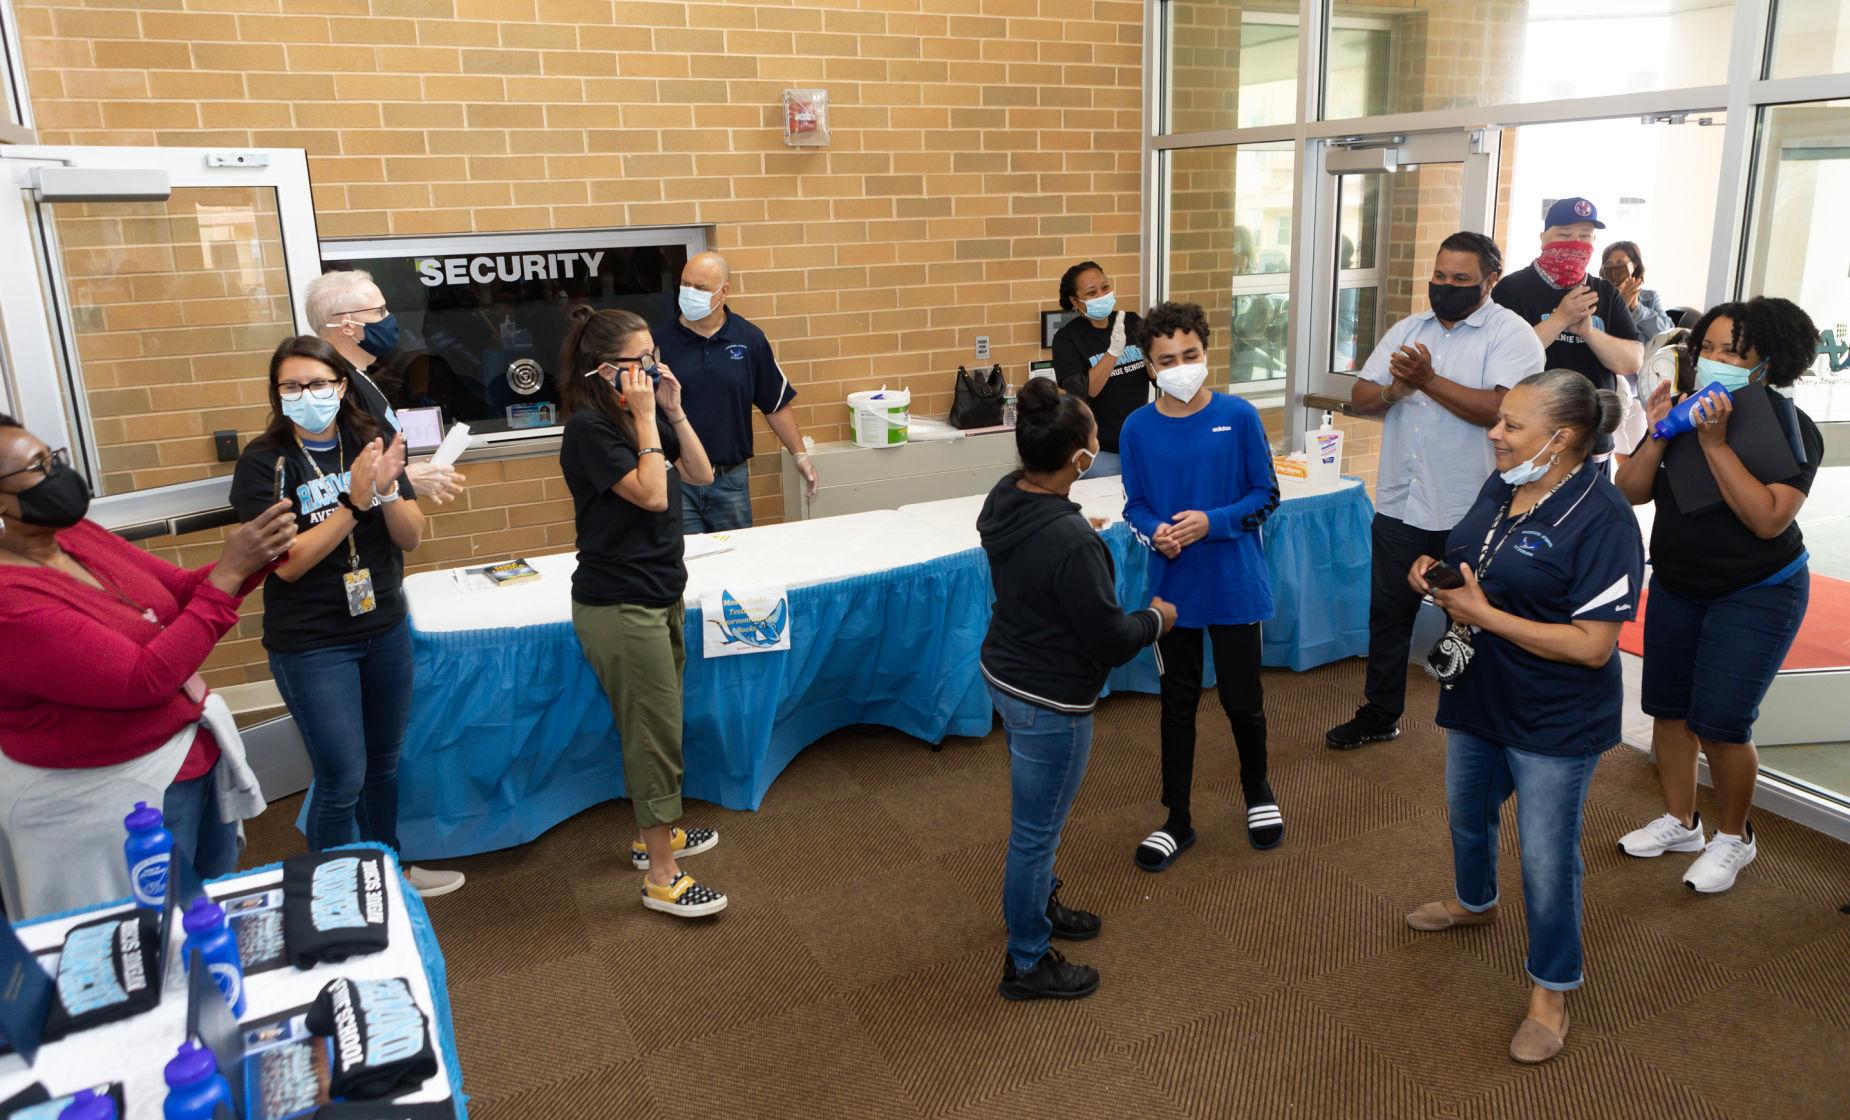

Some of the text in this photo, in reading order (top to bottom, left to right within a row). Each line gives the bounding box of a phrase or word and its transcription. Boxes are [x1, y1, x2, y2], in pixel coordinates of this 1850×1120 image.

[419, 251, 605, 287] SECURITY
[1110, 360, 1146, 377] NUE SCHOO
[335, 1007, 364, 1073] SCHOOL
